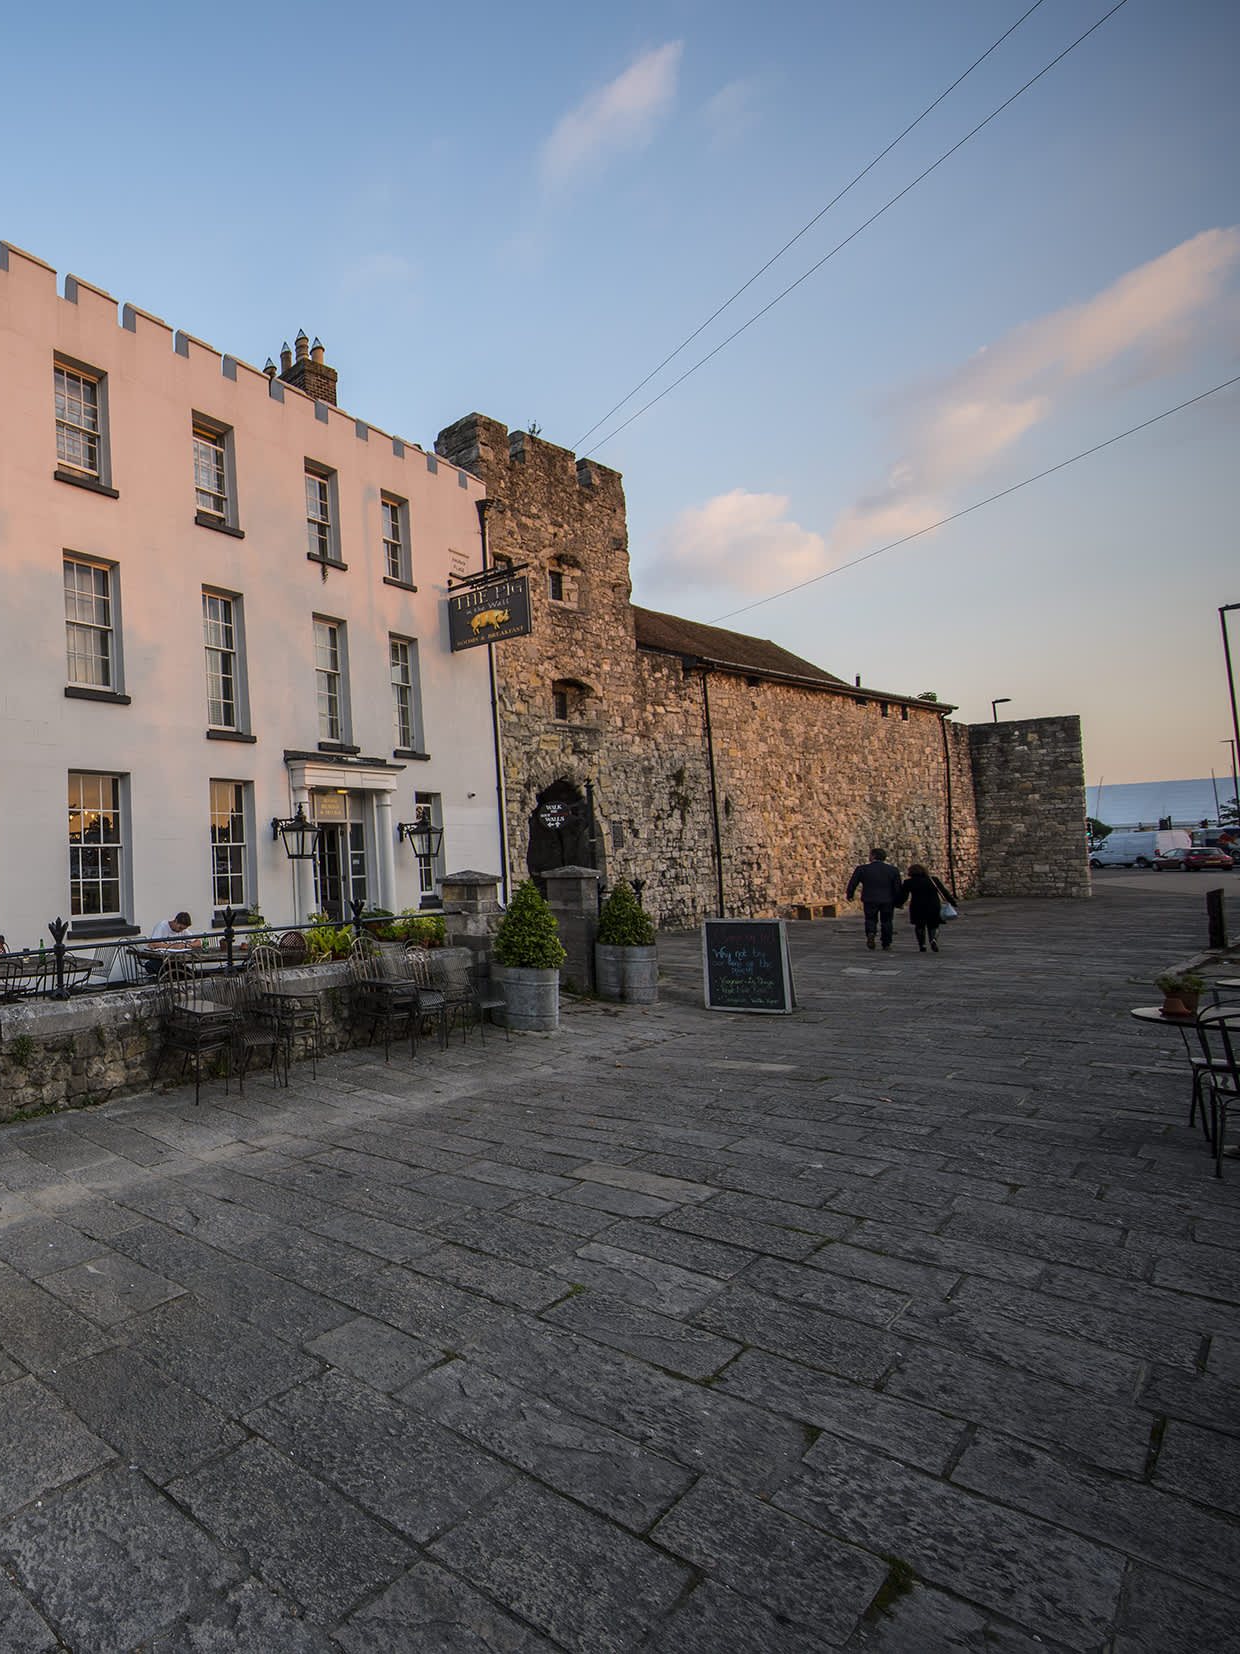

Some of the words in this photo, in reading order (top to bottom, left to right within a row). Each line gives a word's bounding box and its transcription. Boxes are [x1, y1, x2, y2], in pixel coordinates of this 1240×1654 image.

[452, 590, 488, 610] THE
[495, 581, 523, 599] PIG
[488, 598, 510, 608] Wall
[712, 946, 733, 962] Why
